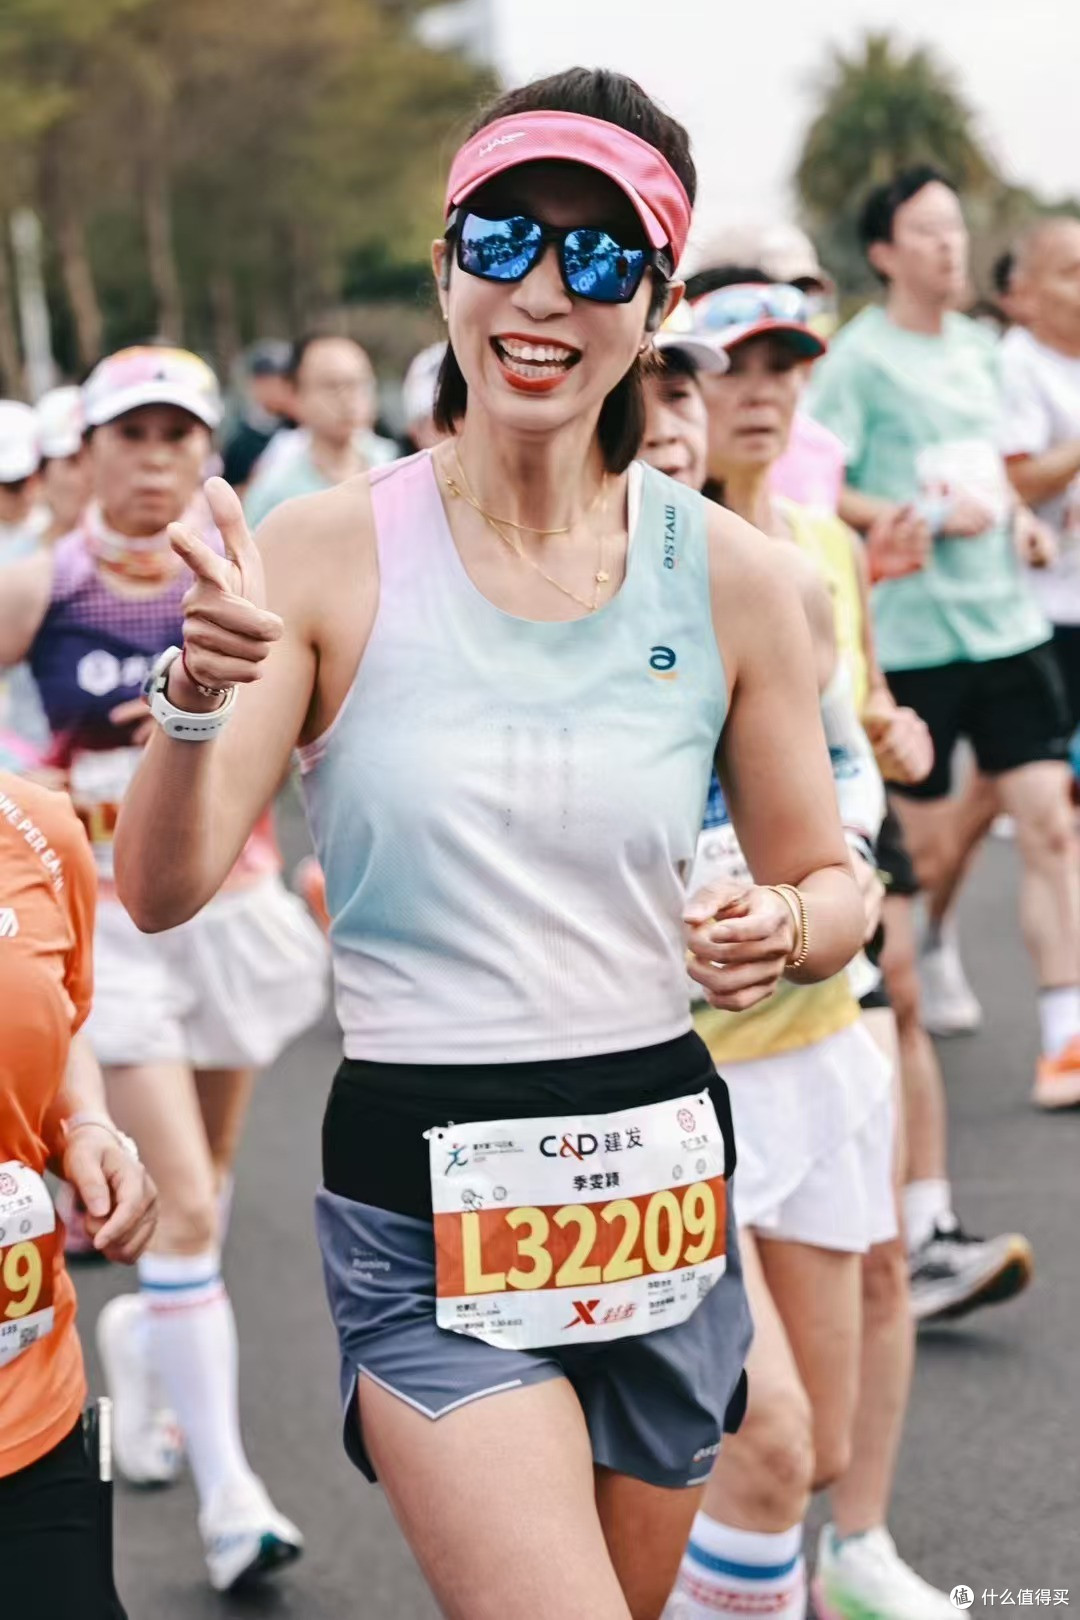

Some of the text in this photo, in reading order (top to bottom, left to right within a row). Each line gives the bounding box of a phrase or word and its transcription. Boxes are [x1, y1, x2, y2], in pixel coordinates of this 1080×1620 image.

[16, 818, 48, 853] PER
[539, 1126, 644, 1161] C&D 建发
[460, 1181, 717, 1296] L32209
[0, 1241, 43, 1319] 9
